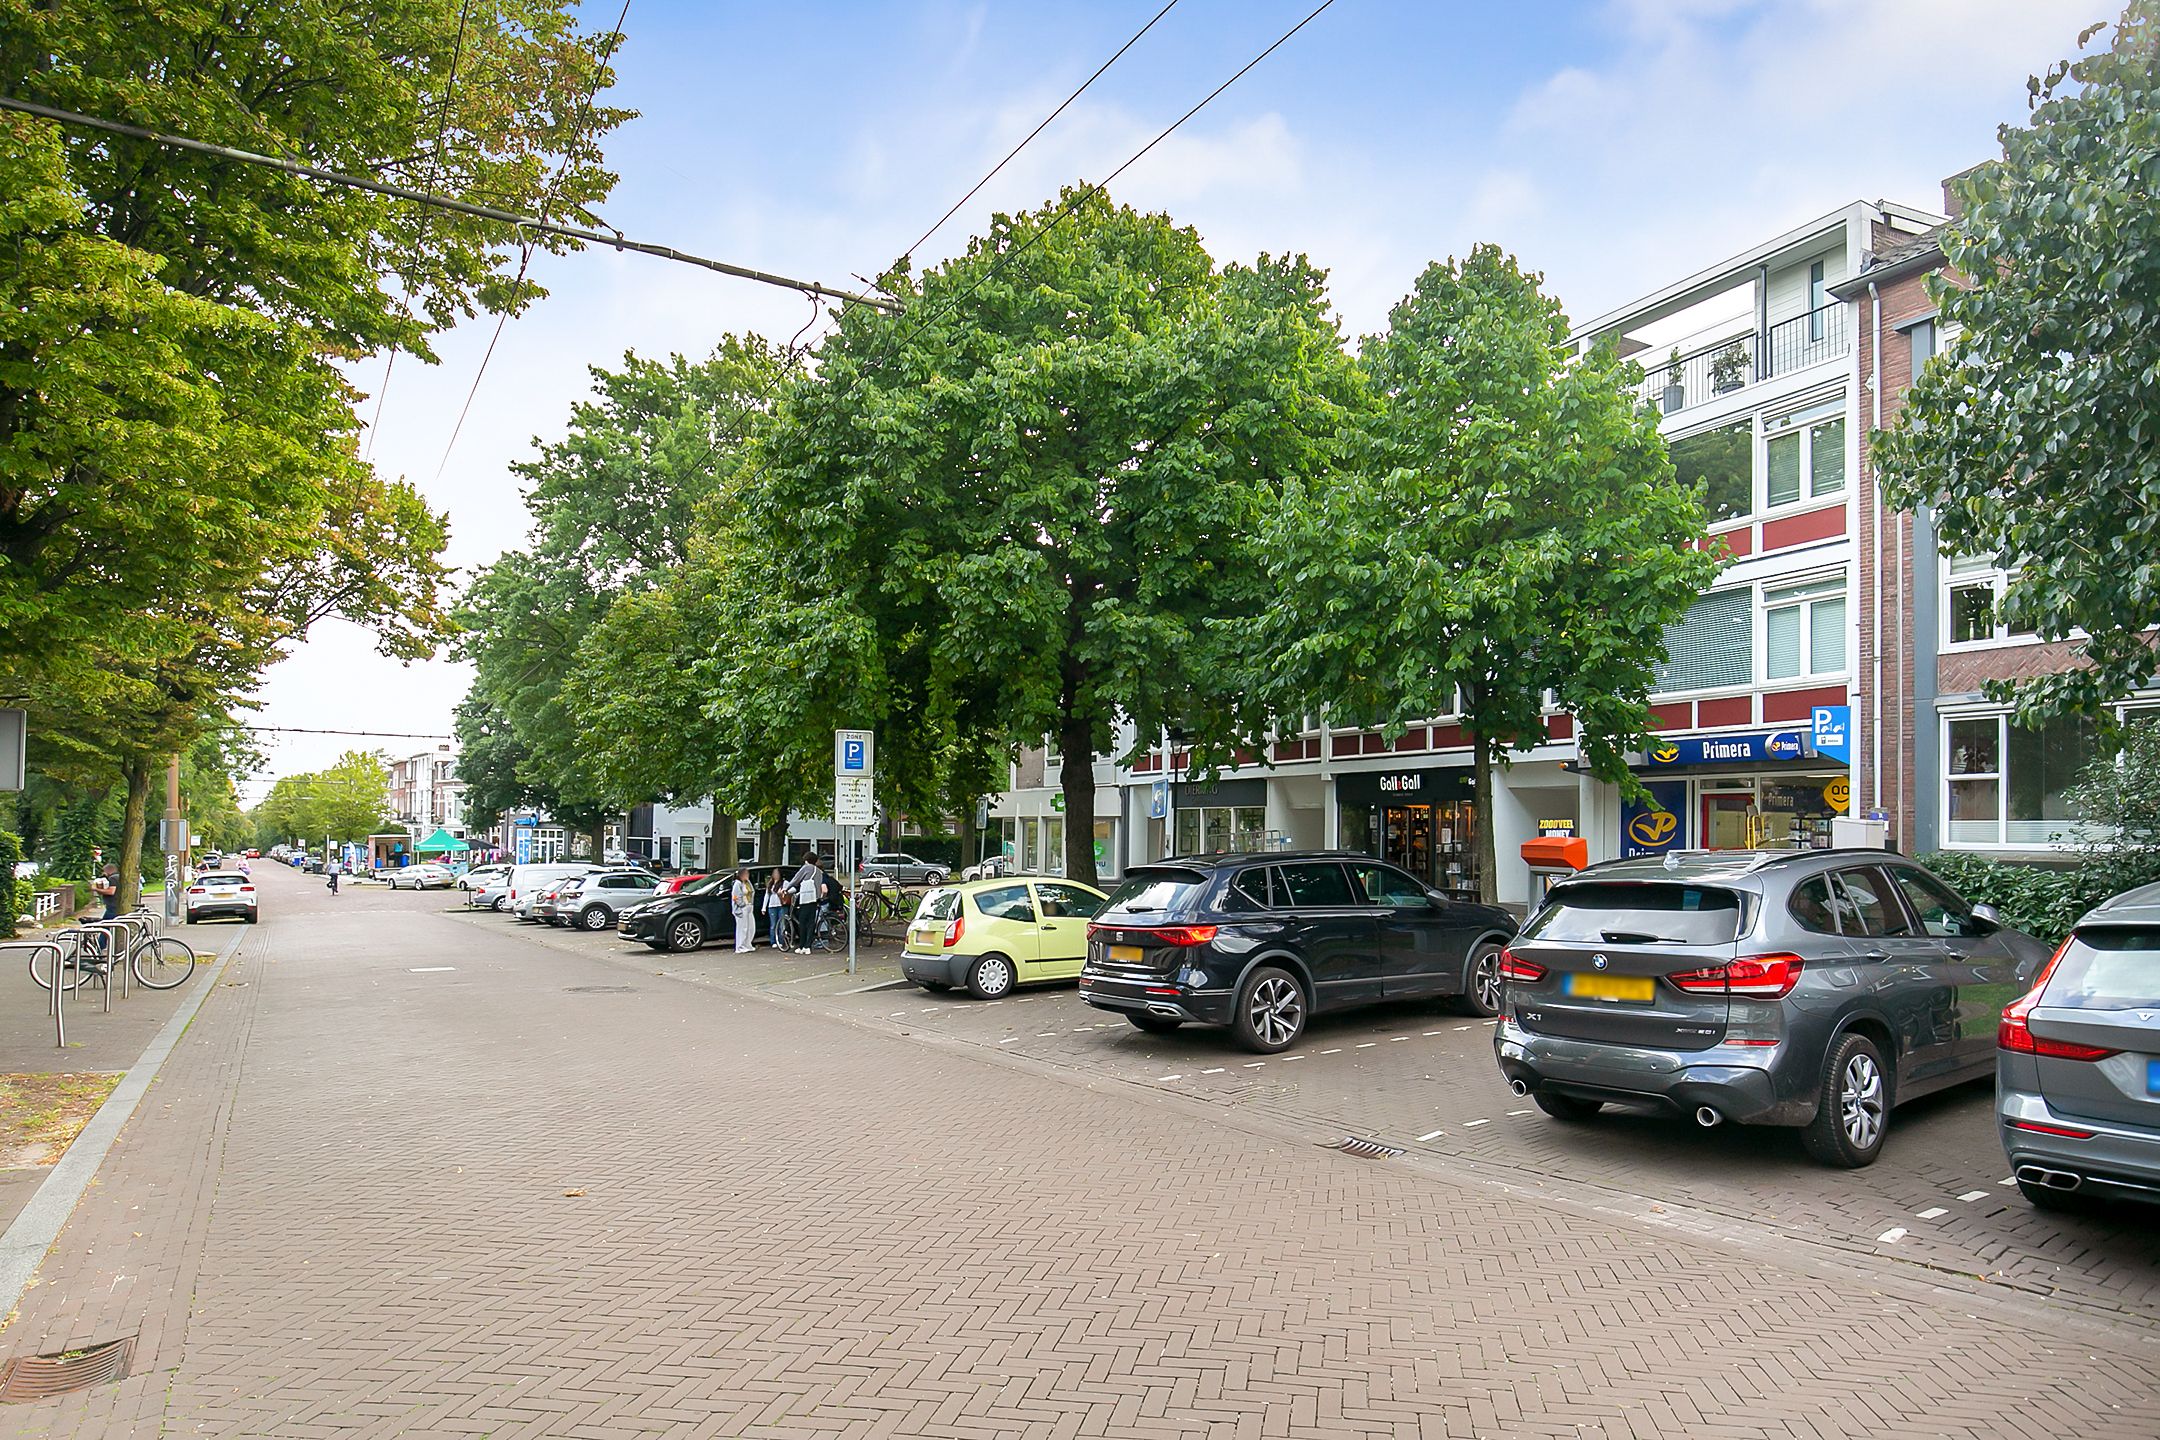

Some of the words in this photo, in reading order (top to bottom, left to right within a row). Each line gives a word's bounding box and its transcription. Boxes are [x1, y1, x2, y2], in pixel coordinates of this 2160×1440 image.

[1815, 709, 1832, 734] P
[848, 743, 860, 758] P
[1703, 741, 1751, 759] Primera
[1781, 741, 1799, 751] Primera
[1526, 1012, 1542, 1021] X1
